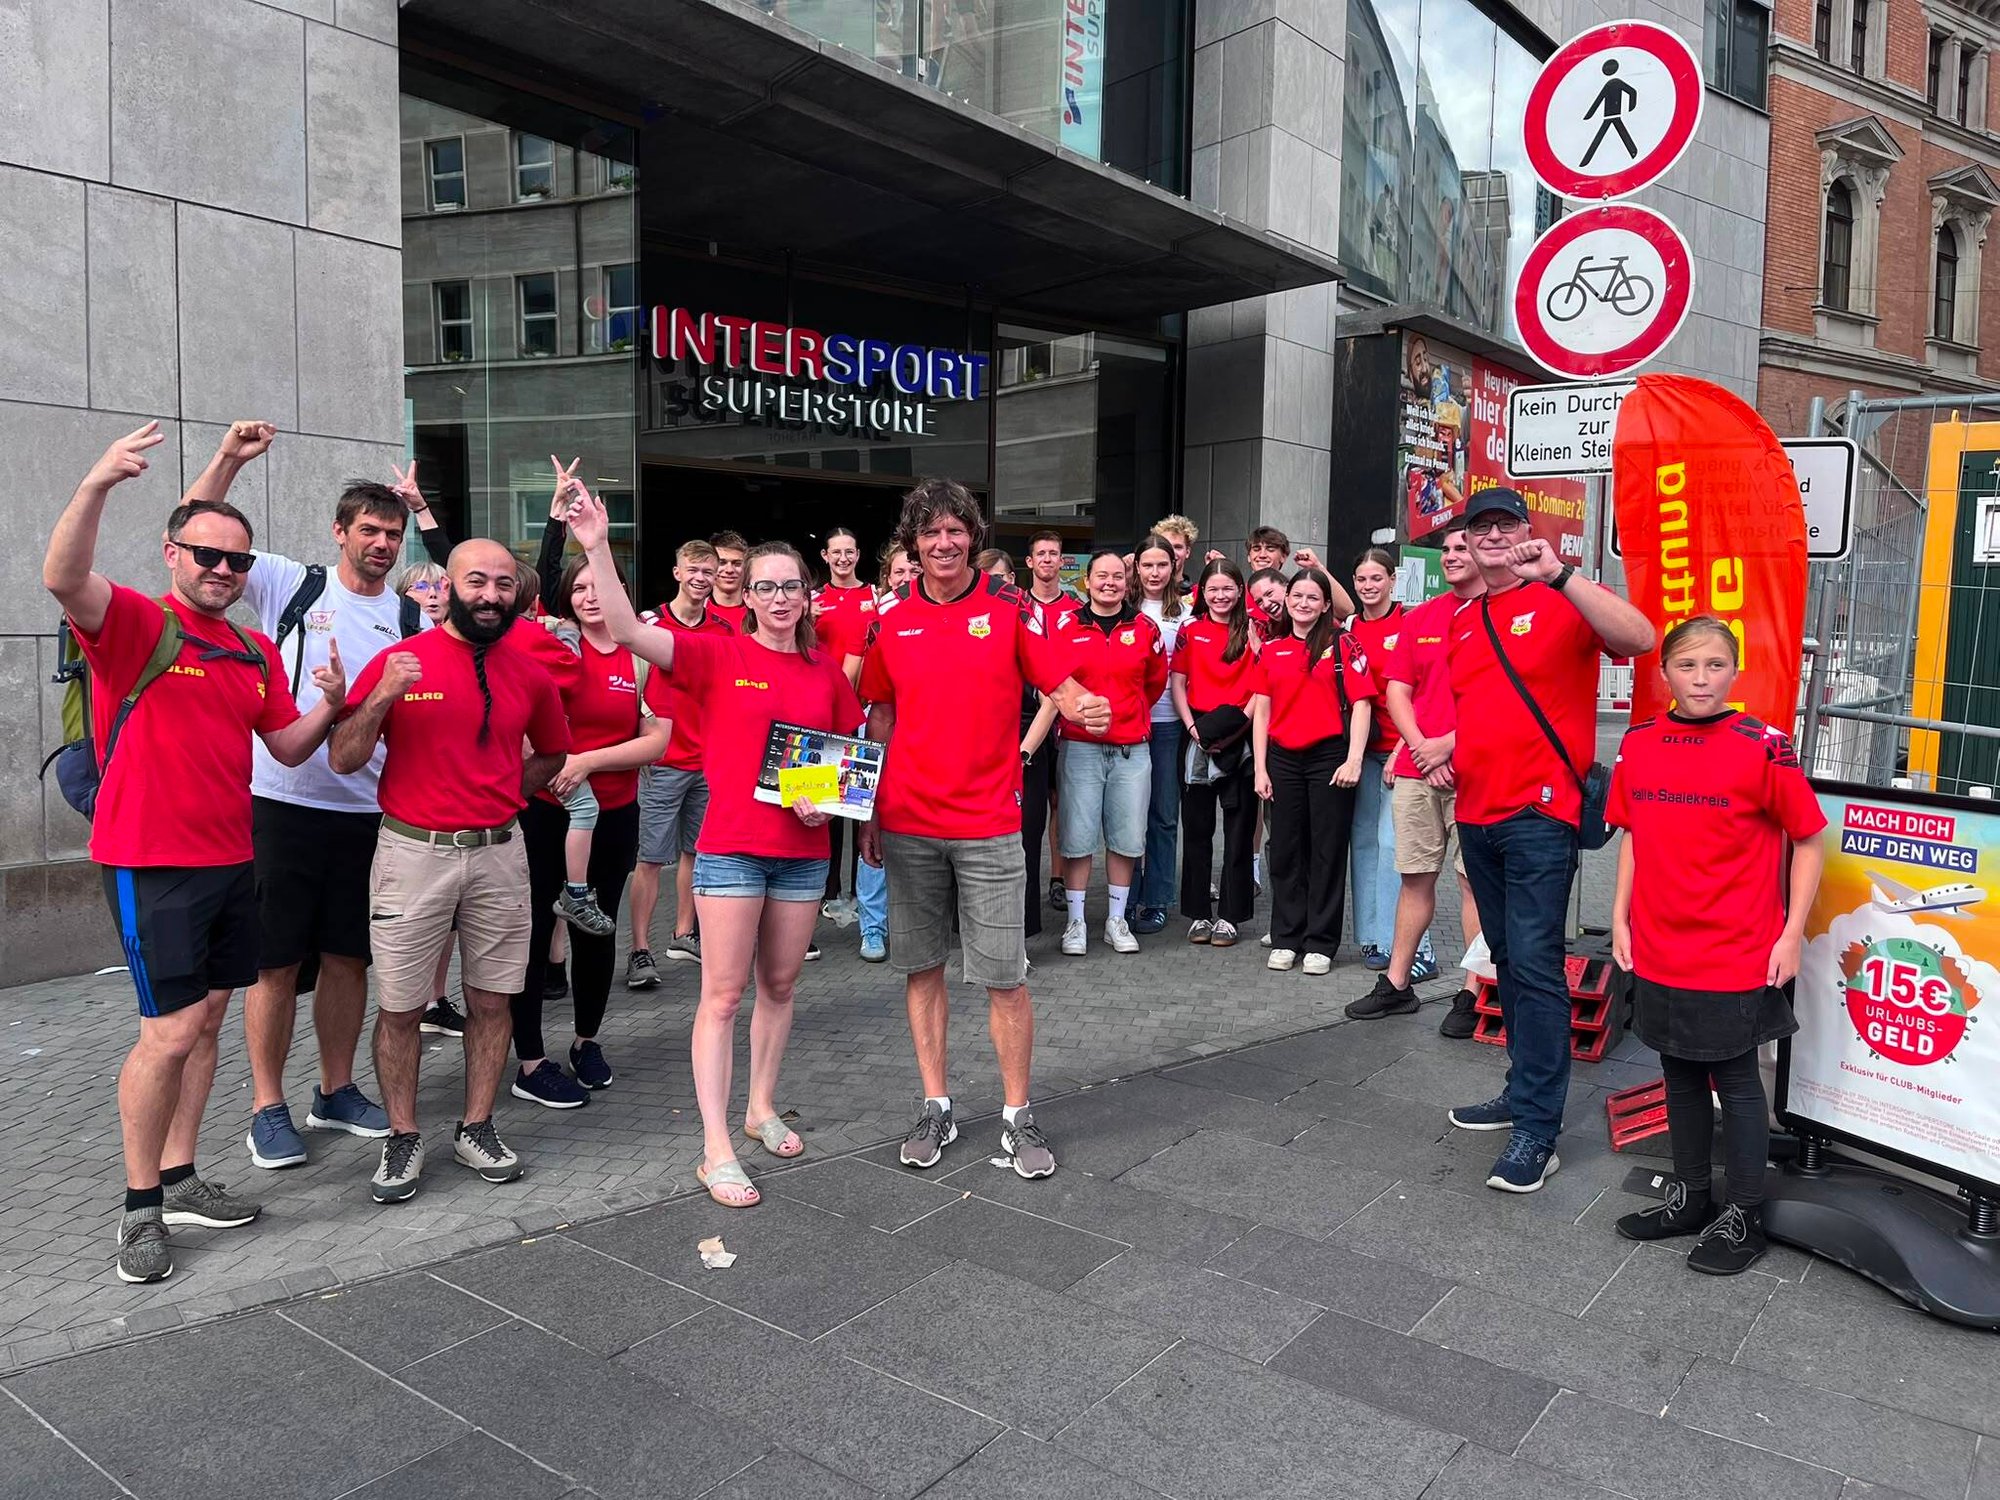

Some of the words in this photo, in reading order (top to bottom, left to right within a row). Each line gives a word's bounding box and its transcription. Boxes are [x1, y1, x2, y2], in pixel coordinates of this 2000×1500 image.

[652, 304, 989, 400] INTERSPORT
[1484, 368, 1501, 397] Hey
[702, 375, 937, 437] SUPERSTORE
[1474, 388, 1501, 426] hier
[1519, 397, 1556, 416] kein
[1567, 391, 1624, 413] Durch
[1487, 427, 1507, 463] de
[1578, 420, 1610, 436] zur
[1514, 443, 1572, 462] Kleinen
[1580, 438, 1612, 458] Stei
[1523, 485, 1537, 511] im
[1537, 489, 1575, 519] Sommer
[404, 692, 443, 701] DLRG
[1662, 736, 1705, 744] DLRG
[1848, 808, 1900, 831] MACH
[1905, 815, 1950, 838] DICH
[1844, 834, 1882, 854] AUF
[1885, 839, 1924, 861] DEN
[1929, 846, 1973, 869] WEG
[1866, 959, 1948, 1012] 15€
[1865, 1004, 1944, 1033] URLAUBS-
[1867, 1021, 1935, 1056] GELD
[1840, 1060, 1874, 1078] Exklusiv
[1876, 1071, 1888, 1082] für
[1889, 1075, 1963, 1105] CLUB-Mitglieder
